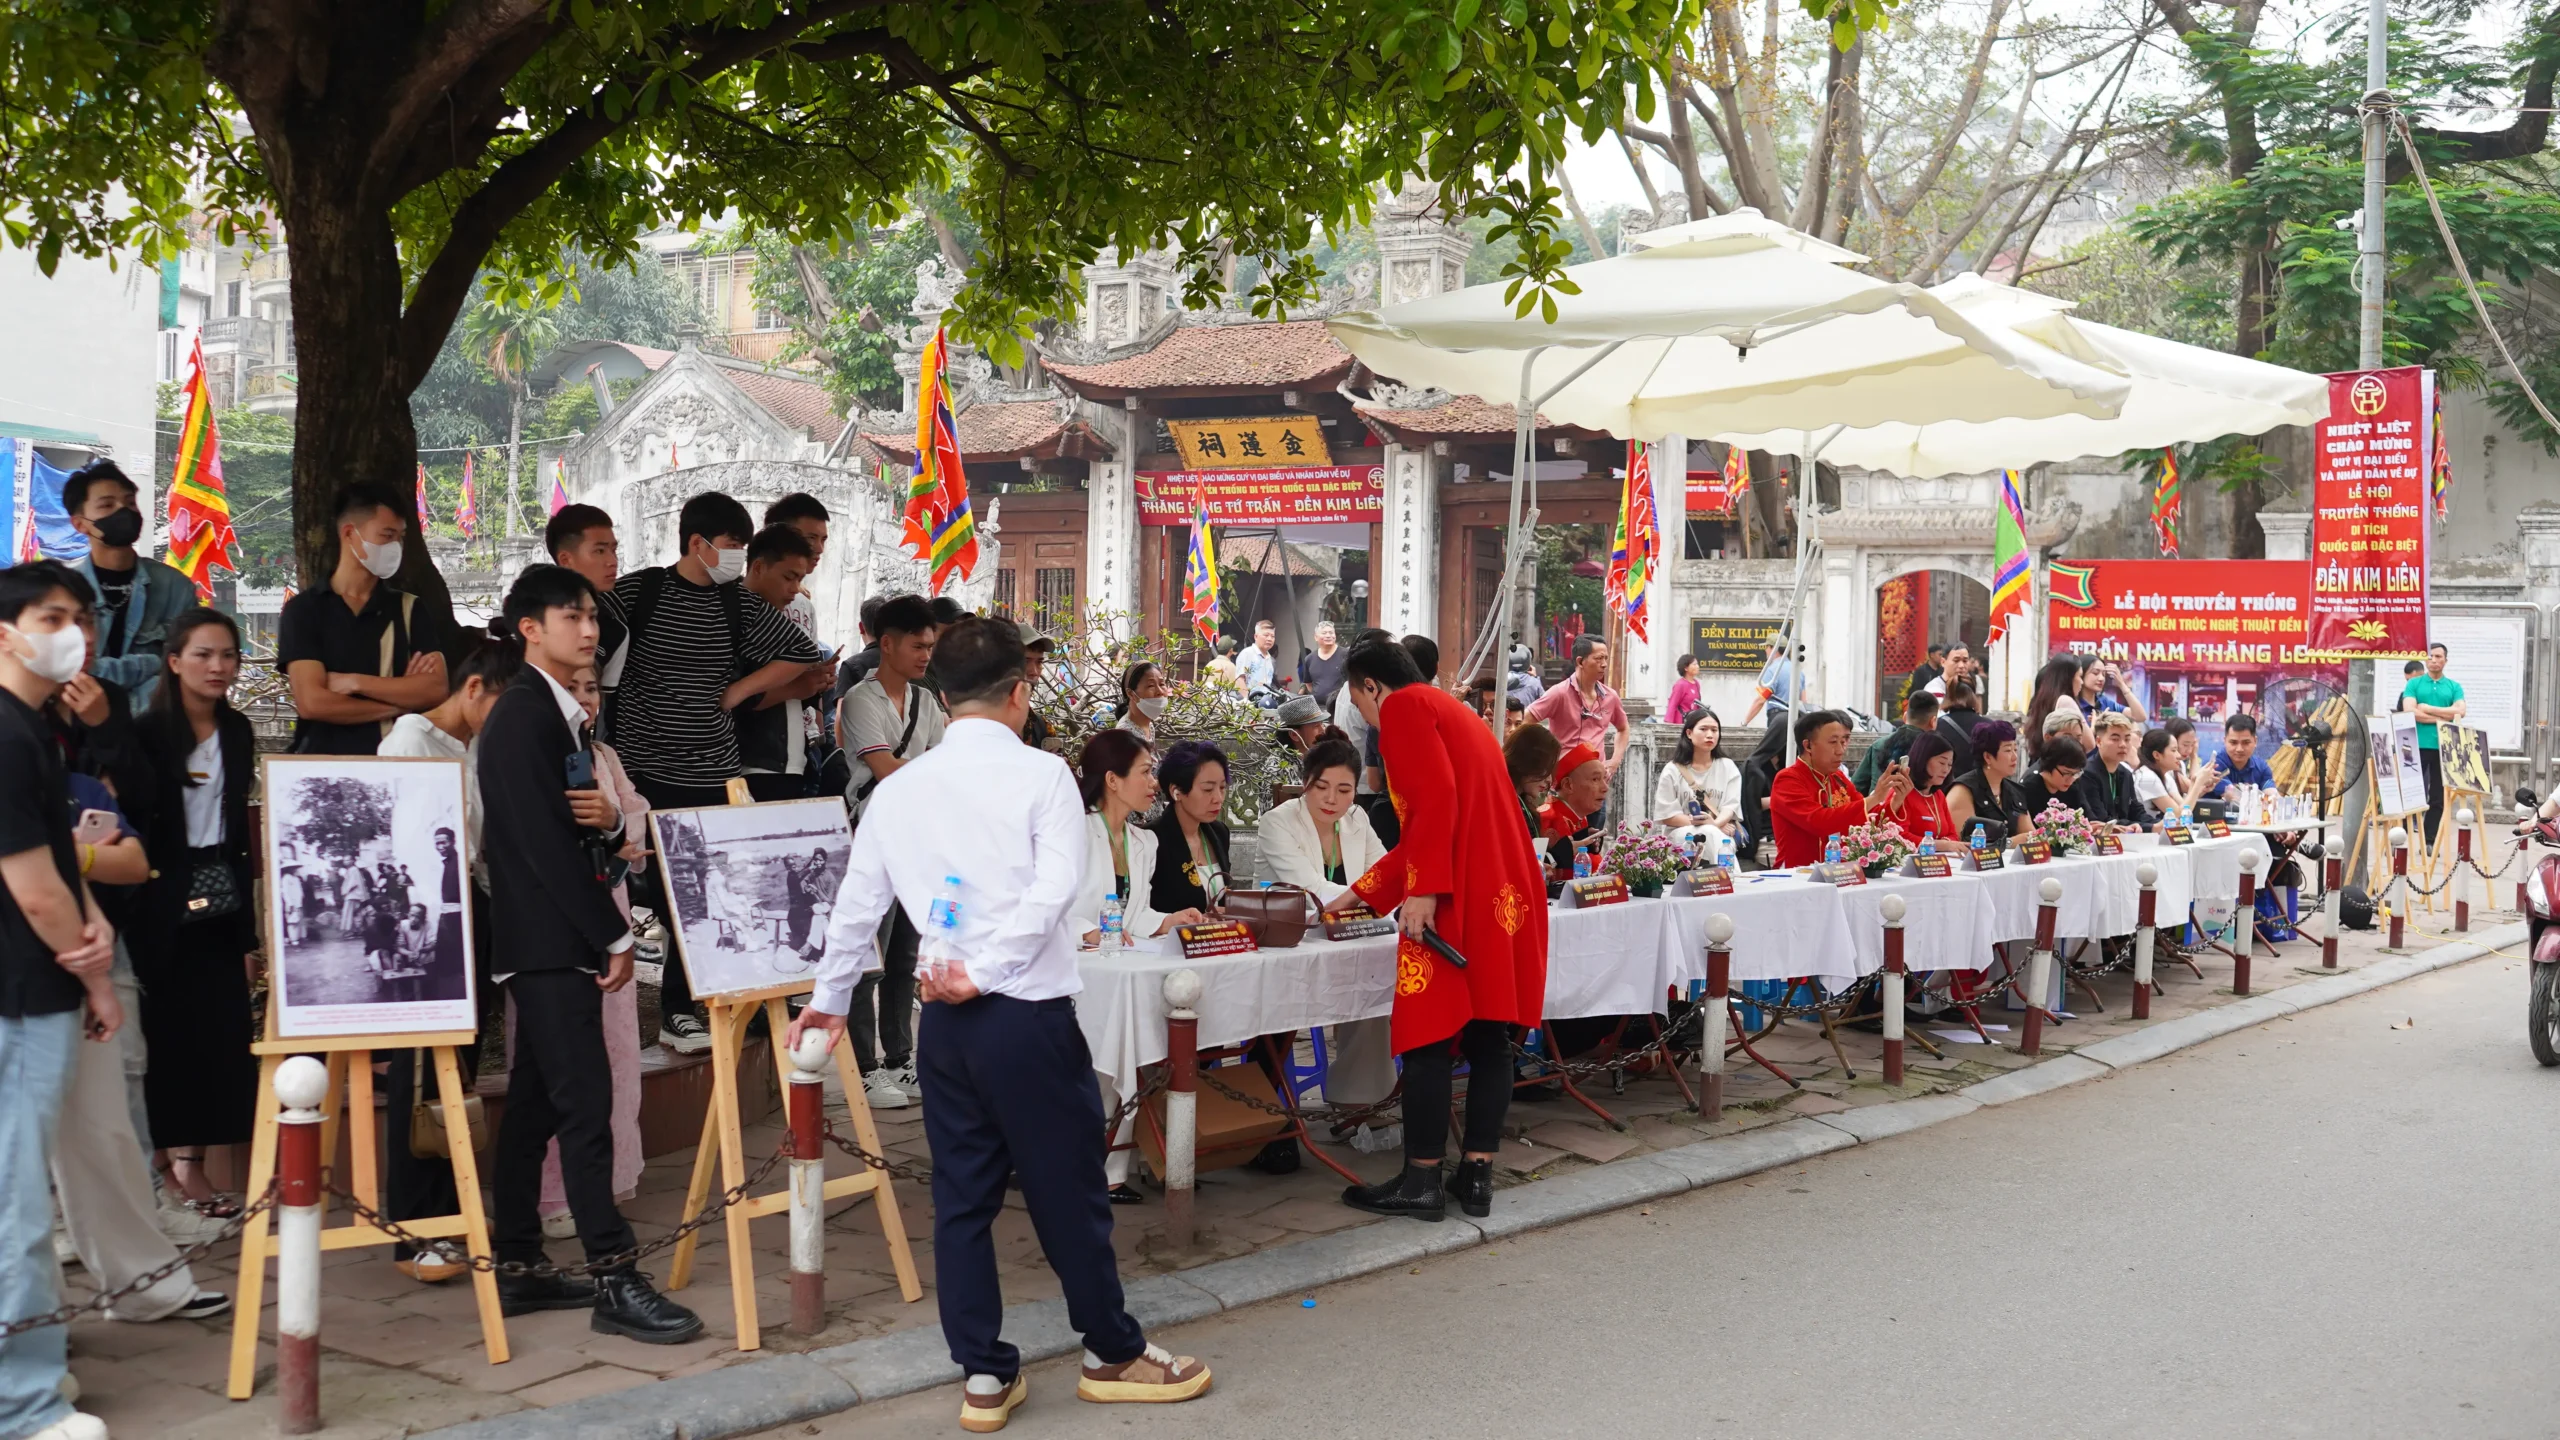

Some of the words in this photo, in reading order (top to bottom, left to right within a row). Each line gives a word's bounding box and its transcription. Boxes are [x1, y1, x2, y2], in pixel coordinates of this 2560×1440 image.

[2327, 421, 2372, 437] NHIỆT
[2377, 419, 2412, 435] LIỆT
[2326, 438, 2364, 453] CHÀO
[2369, 436, 2412, 451] MỪNG
[2353, 456, 2361, 467] VỊ
[2363, 455, 2382, 467] ĐẠI
[1167, 473, 1184, 483] NHIỆT
[1201, 473, 1216, 482] HÀO
[1216, 472, 1235, 482] MỪNG
[1286, 470, 1295, 479] VÀ
[1296, 470, 1314, 479] NHÂN
[1315, 470, 1329, 479] DÂN
[2320, 470, 2334, 482] VÀ
[2336, 468, 2362, 481] NHÂN
[2365, 467, 2387, 479] DÂN
[2404, 467, 2418, 480] DỰ
[1158, 483, 1169, 495] LỄ
[1170, 485, 1185, 496] HỘI
[1220, 483, 1248, 495] THỐNG
[1249, 485, 1258, 494] DI
[1260, 483, 1280, 494] TÍCH
[1282, 481, 1304, 493] QUỐC
[1306, 483, 1321, 492] GIA
[1322, 482, 1340, 493] ĐẶC
[1341, 480, 1363, 493] BIỆT
[2366, 483, 2392, 500] HỘI
[1142, 499, 1185, 514] THĂNG
[1225, 498, 1243, 514] TỨ
[1246, 496, 1282, 514] TRẤN
[1295, 494, 1322, 512] ĐỀN
[1326, 498, 1352, 511] KIM
[1355, 494, 1384, 510] LIÊN
[2319, 502, 2369, 521] TRUYỀN
[2373, 502, 2419, 519] THỐNG
[2351, 525, 2360, 536] DI
[2363, 522, 2388, 535] TÍCH
[2319, 538, 2349, 553] QUỐC
[2351, 540, 2368, 551] GIA
[2370, 538, 2393, 553] ĐẶC
[2396, 537, 2418, 553] BIỆT
[2315, 557, 2349, 592] ĐỀN
[2353, 566, 2381, 592] KIM
[2386, 561, 2420, 592] LIÊN
[2114, 589, 2135, 610] LỄ
[2139, 592, 2168, 613] HỘI
[2171, 590, 2236, 611] TRUYỀN
[2240, 591, 2297, 612] THỐNG
[1701, 623, 1725, 638] ĐỀN
[1728, 628, 1752, 639] KIM
[2059, 616, 2071, 629] DI
[2072, 614, 2097, 630] TÍCH
[2098, 616, 2123, 632] LỊCH
[2126, 614, 2142, 630] SỬ
[2150, 614, 2177, 631] KIẾN
[2179, 616, 2207, 631] TRÚC
[2209, 616, 2239, 634] NGHỆ
[2241, 617, 2276, 635] THUẬT
[1708, 640, 1723, 649] TRẤN
[1724, 642, 1737, 650] NAM
[1738, 642, 1758, 650] THĂNG
[2069, 635, 2129, 660] TRẤN
[2136, 642, 2185, 662] NAM
[2192, 640, 2272, 664] THĂNG
[1708, 659, 1723, 667] TÍCH
[1723, 659, 1741, 668] QUỐC
